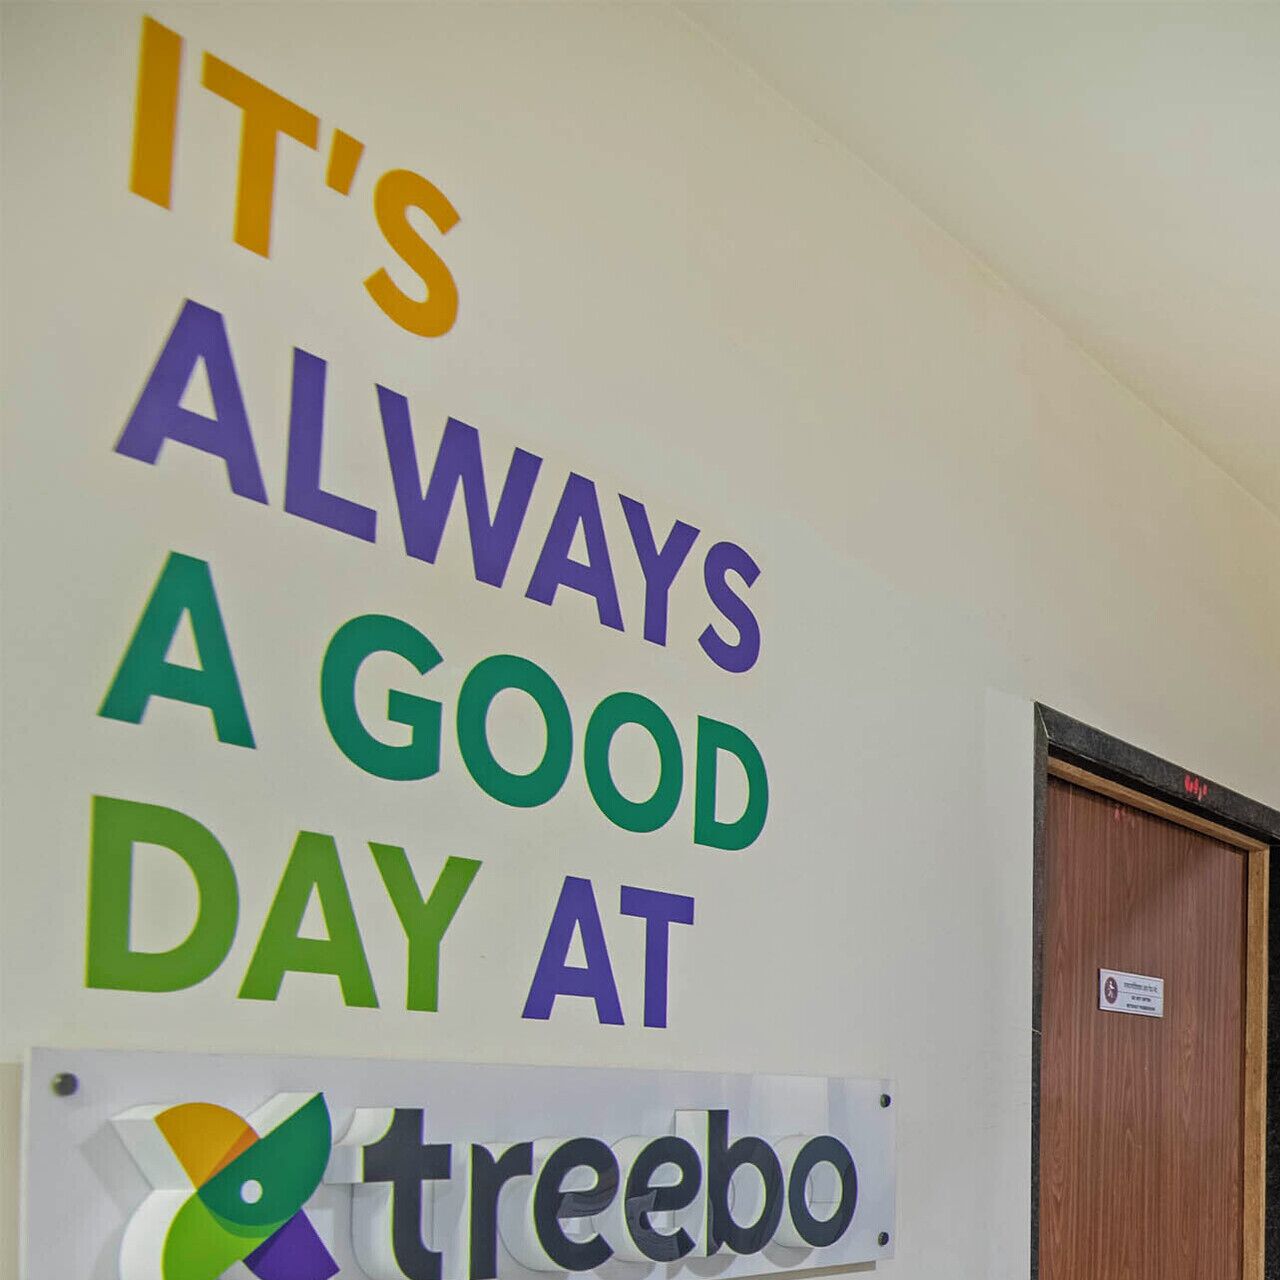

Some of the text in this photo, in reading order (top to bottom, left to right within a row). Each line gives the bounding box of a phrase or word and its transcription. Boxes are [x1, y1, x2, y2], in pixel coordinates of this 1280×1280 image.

[128, 14, 460, 338] IT'S
[114, 298, 760, 674] ALWAYS
[97, 551, 769, 851] A GOOD
[83, 795, 695, 1028] DAY AT
